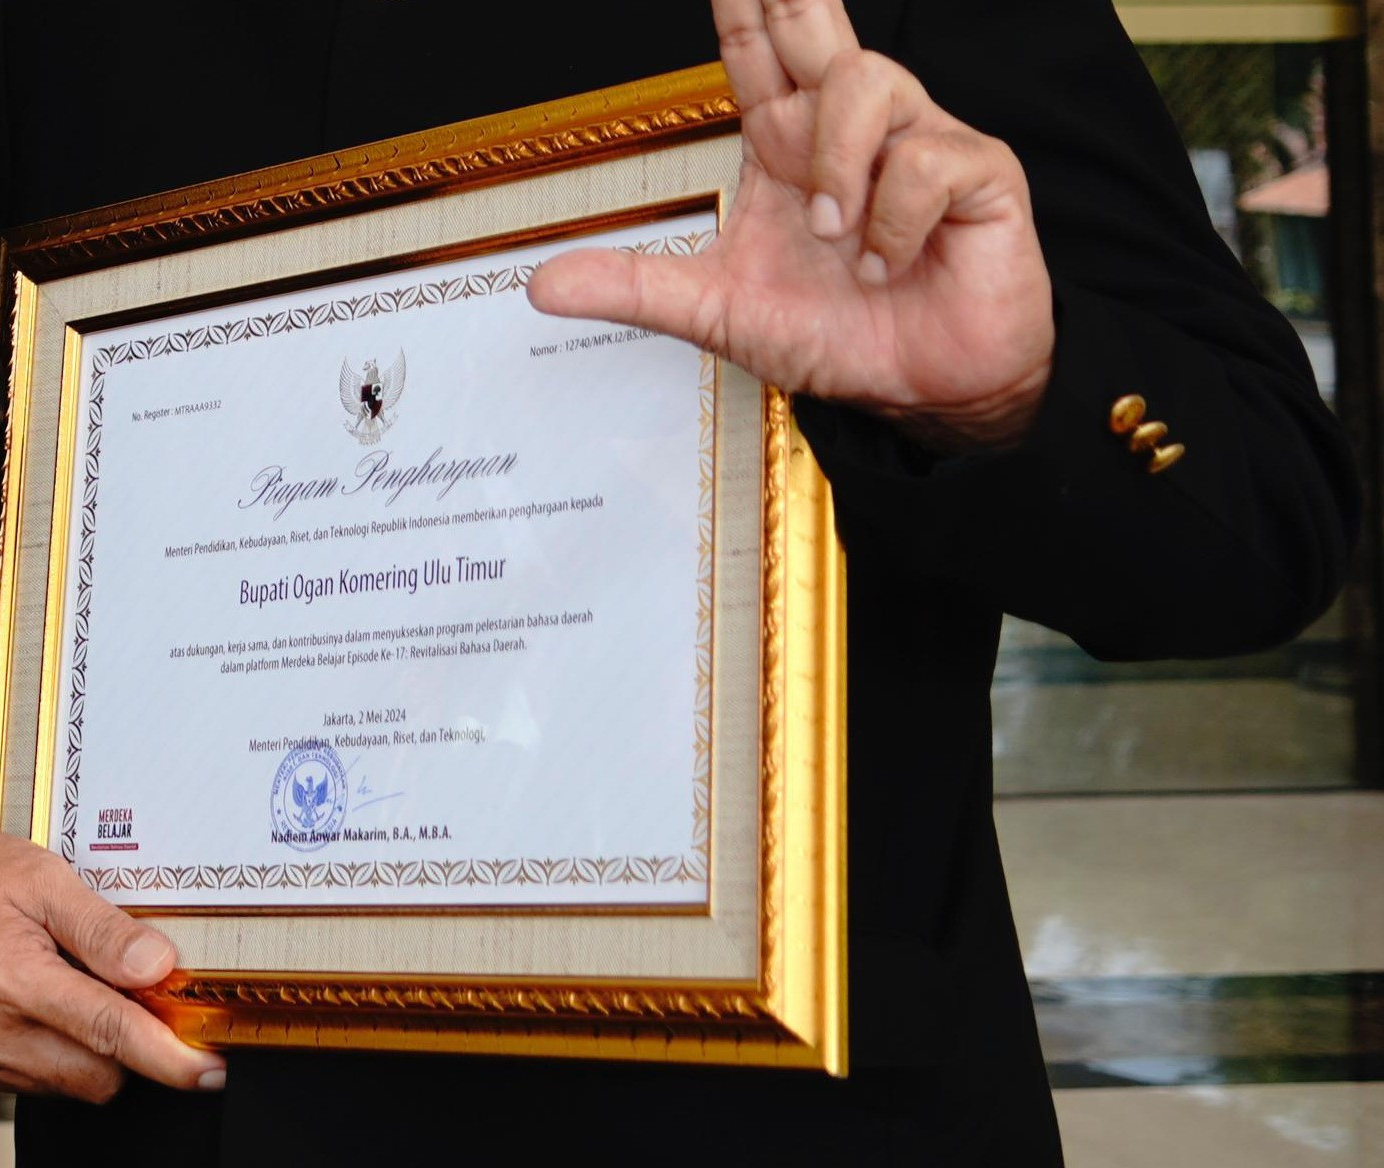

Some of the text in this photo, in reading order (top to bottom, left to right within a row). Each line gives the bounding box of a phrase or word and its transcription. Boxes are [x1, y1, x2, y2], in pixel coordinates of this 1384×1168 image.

[530, 344, 558, 357] Nomor
[144, 408, 170, 421] Register
[237, 447, 518, 522] Piagam Penghargaan
[165, 494, 604, 558] Menteri Pendidikan, Kebudayaan, Riset, dan Teknologi Republik Indonesia memberikan penghargaan kepada
[240, 556, 507, 608] Bupati Ogan Komering Ulu Timur
[169, 608, 593, 660] atas dukungan, kerja sama, dan kontribusinya dalam menyukseskan program pelestarian bahasa daerah
[220, 661, 244, 674] dalam
[245, 658, 280, 674] platform
[281, 654, 316, 669] Merdeka
[317, 651, 346, 668] Belajar
[347, 649, 379, 666] Episode
[410, 642, 458, 658] Revitalisasi
[460, 640, 491, 654] Bahasa
[493, 637, 527, 652] Daerah.
[323, 708, 406, 727] Jakarta, 2 Mei 2024
[249, 727, 485, 752] Menteri Pendidikan, Kebudayaan, Riset, dan Teknologi,
[99, 808, 132, 822] MERDEKA
[97, 823, 132, 839] BELAJAR
[271, 825, 452, 843] Nadiem Anwar Makarim, B.A., M.B.A.
